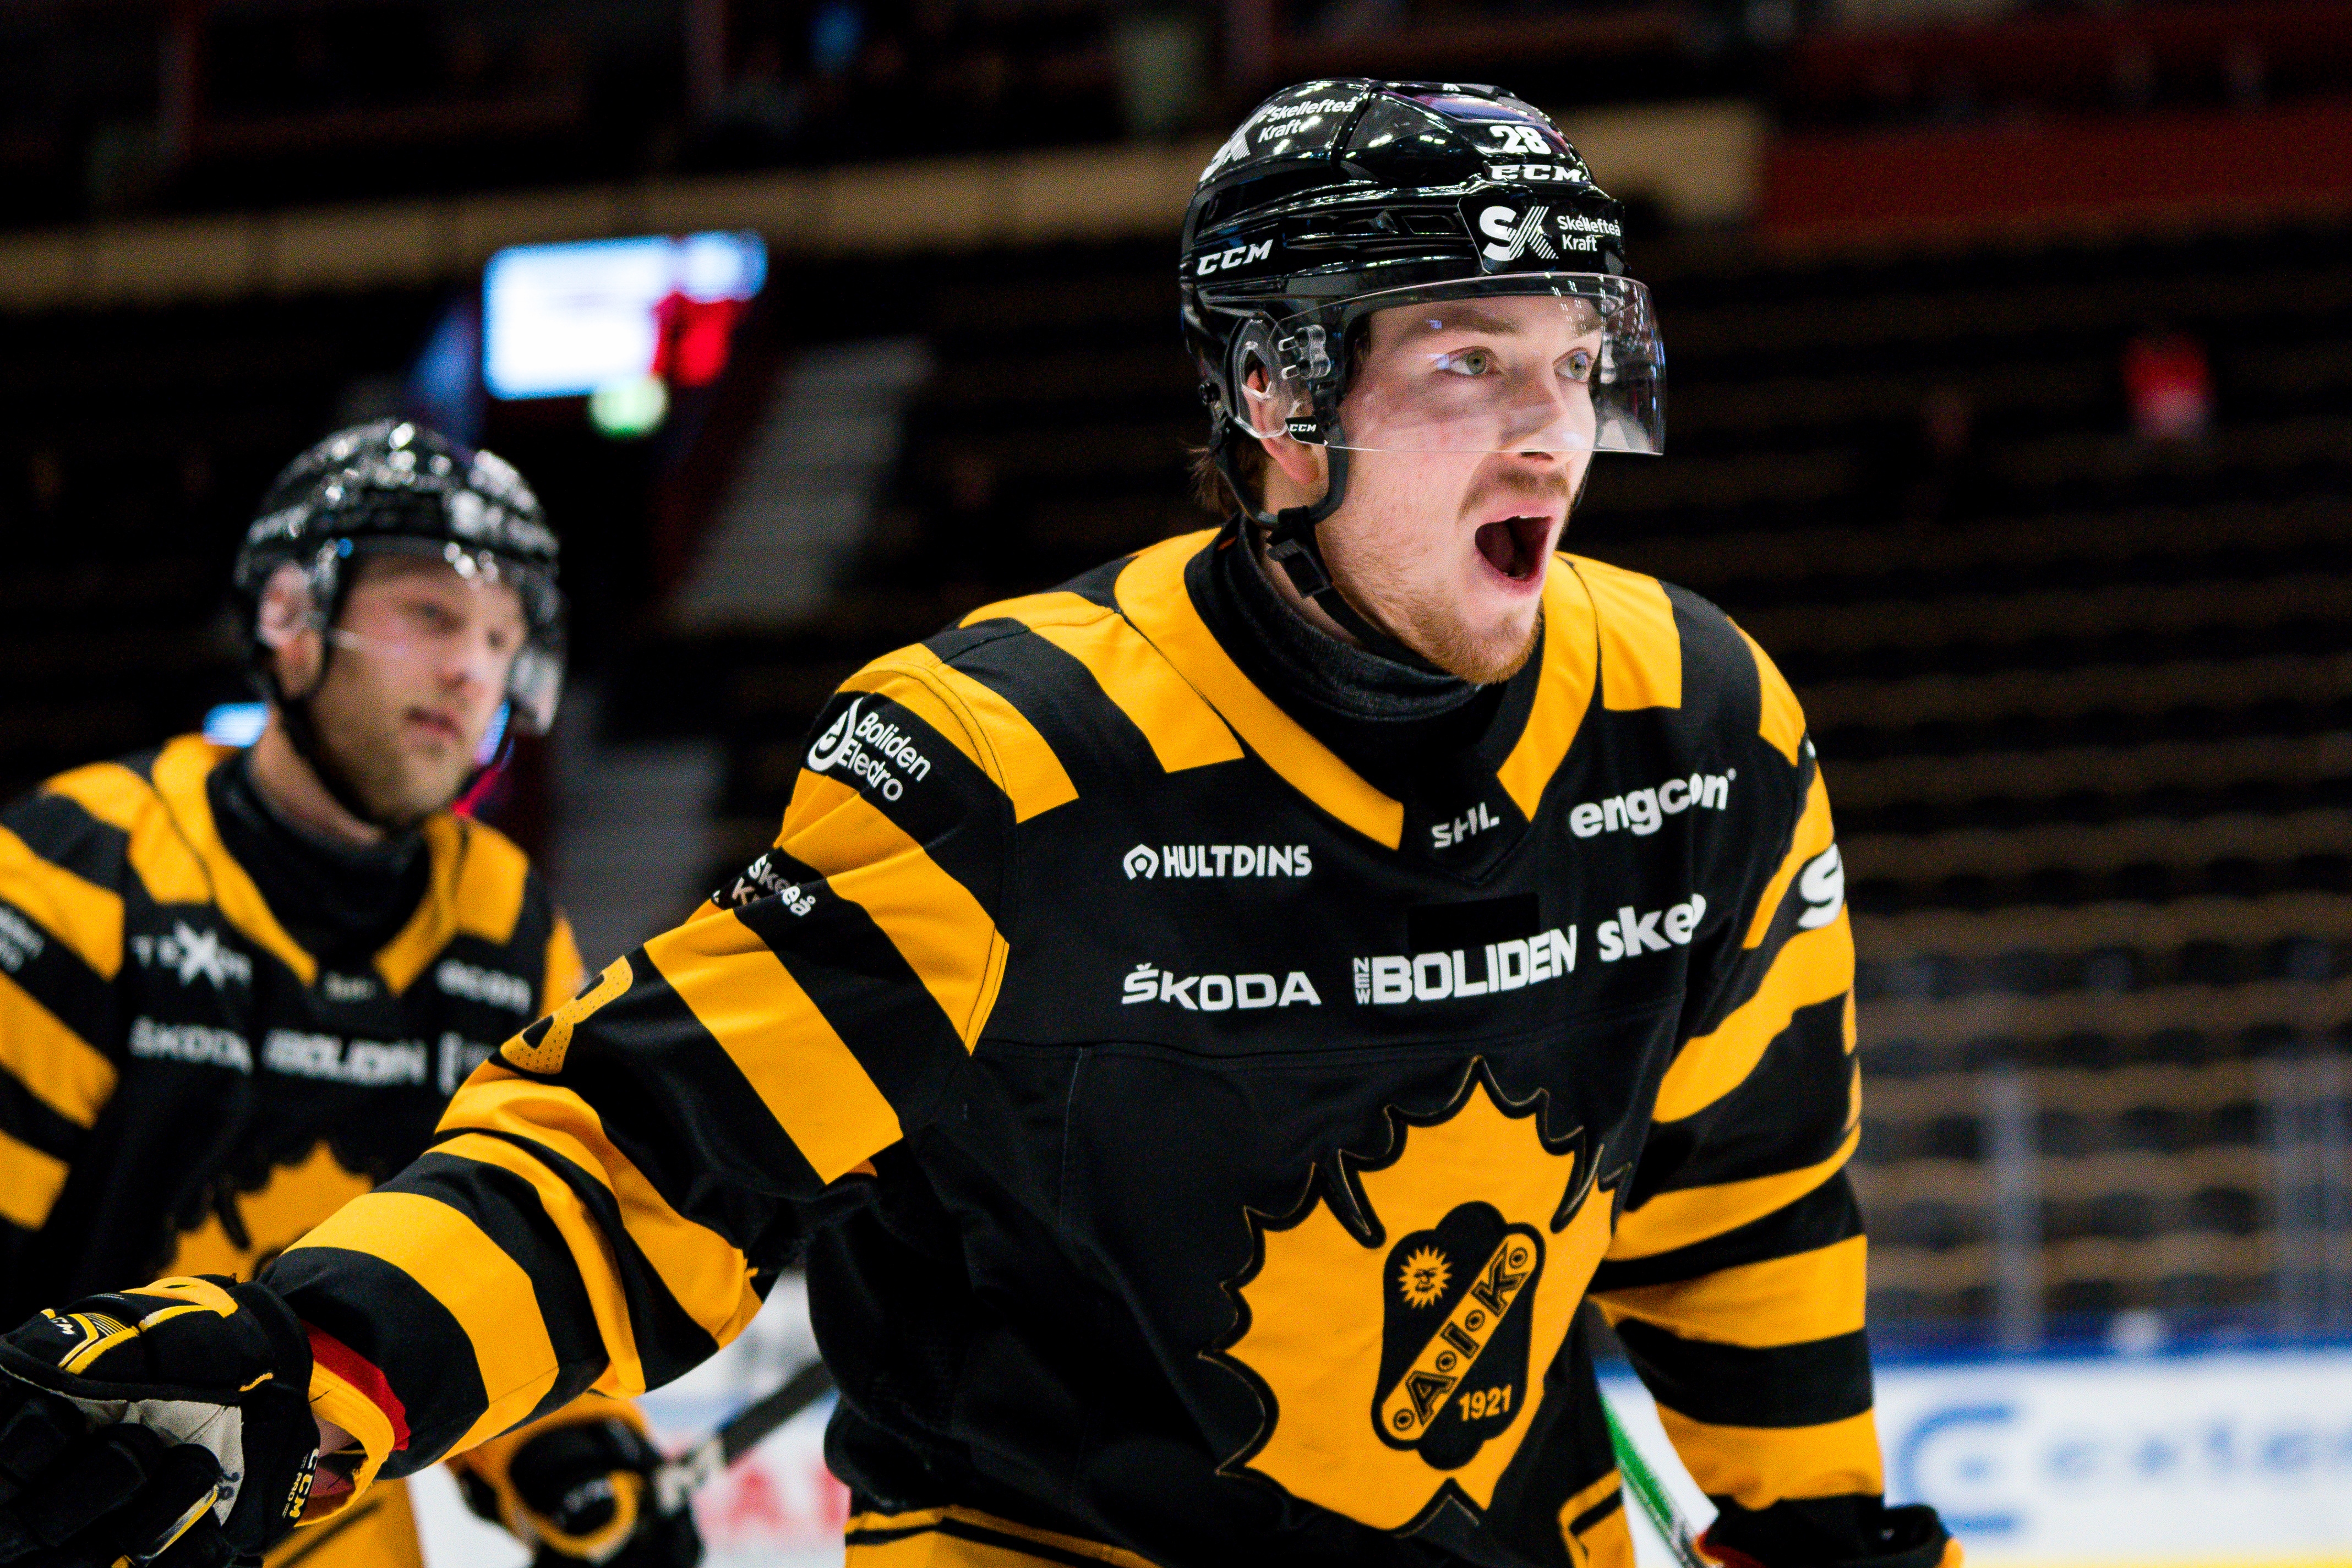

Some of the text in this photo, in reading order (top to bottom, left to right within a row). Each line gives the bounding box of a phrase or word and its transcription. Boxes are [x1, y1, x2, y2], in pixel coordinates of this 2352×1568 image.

[1257, 119, 1302, 143] Kraft
[1489, 125, 1551, 155] 28
[1197, 239, 1273, 275] CCM
[1562, 234, 1597, 252] Kraft
[1290, 424, 1317, 432] CCM
[855, 711, 931, 782] Boliden
[1432, 801, 1500, 848] SHL
[1163, 844, 1313, 877] HULTDINS
[1354, 957, 1371, 1004] NEW
[1372, 924, 1577, 1005] BOLIDEN
[1121, 962, 1322, 1012] ŠKODA
[1459, 1384, 1513, 1422] 1921
